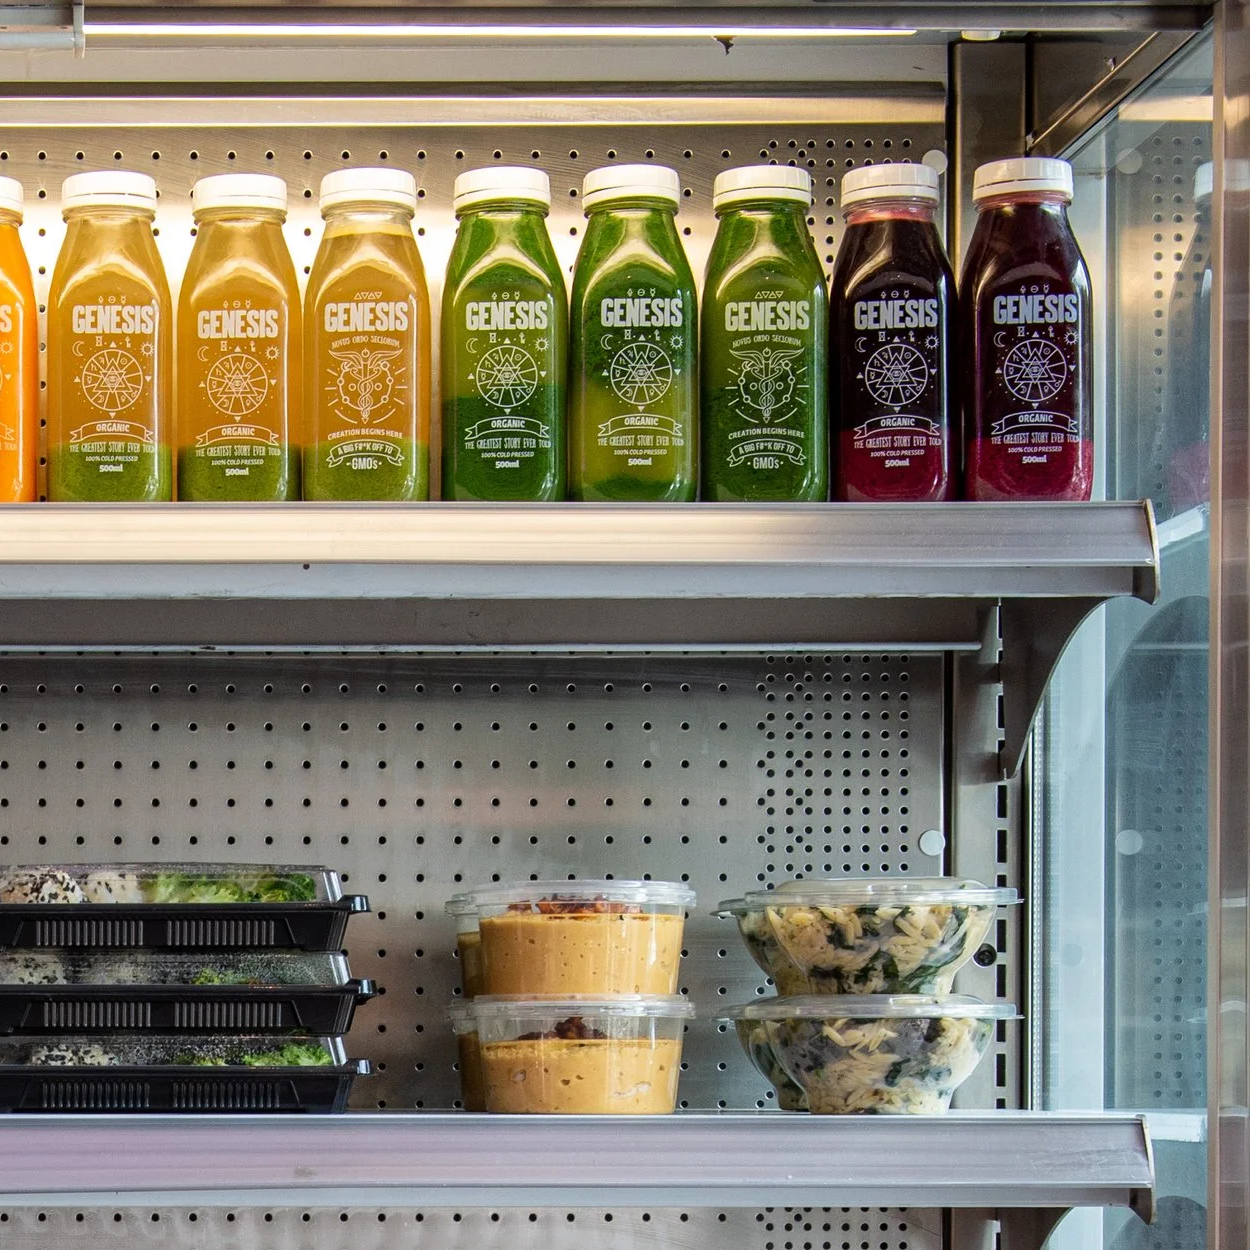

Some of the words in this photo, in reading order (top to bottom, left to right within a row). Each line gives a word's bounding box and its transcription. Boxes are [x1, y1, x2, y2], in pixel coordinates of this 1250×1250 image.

[601, 298, 682, 327] GENESIS
[854, 299, 938, 330] GENESIS
[994, 294, 1077, 325] GENESIS
[72, 305, 153, 334] GENESIS
[324, 302, 408, 332] GENESIS
[466, 302, 548, 330] GENESIS
[725, 302, 810, 331] GENESIS
[198, 310, 278, 338] GENESIS
[491, 419, 525, 428] ORGANIC
[625, 416, 659, 426] ORGANIC
[881, 417, 915, 427] ORGANIC
[1019, 413, 1053, 423] ORGANIC
[97, 423, 129, 432] ORGANIC
[222, 427, 255, 436] ORGANIC
[328, 429, 360, 440] CREATION
[386, 431, 402, 439] HERE
[729, 429, 761, 439] CREATION
[788, 430, 804, 438] HERE
[992, 436, 1001, 444] THE
[1004, 433, 1029, 445] GREATEST
[1031, 432, 1049, 444] STORY
[1051, 433, 1065, 443] EVER
[465, 441, 475, 449] THE
[477, 438, 502, 449] GREATEST
[504, 438, 521, 449] STORY
[523, 438, 537, 448] EVER
[598, 438, 607, 446] THE
[610, 435, 635, 447] GREATEST
[637, 435, 654, 446] STORY
[656, 436, 670, 446] EVER
[854, 440, 864, 449] THE
[866, 436, 891, 449] GREATEST
[894, 436, 911, 448] STORY
[913, 436, 927, 446] EVER
[70, 444, 79, 453] THE
[82, 441, 106, 453] GREATEST
[109, 441, 125, 453] STORY
[128, 443, 140, 453] EVER
[196, 449, 205, 457] THE
[207, 445, 232, 457] GREATEST
[234, 445, 251, 456] STORY
[253, 446, 266, 456] EVER
[343, 445, 354, 453] BIG
[372, 443, 384, 451] OFF
[385, 445, 393, 454] TO
[739, 447, 744, 455] A
[745, 444, 755, 452] BIG
[786, 445, 794, 453] TO
[495, 460, 519, 469] 500ml
[628, 457, 652, 466] 500ml
[885, 458, 909, 468] 500ml
[1023, 454, 1047, 464] 500ml
[100, 463, 123, 473] 500ml
[225, 467, 249, 476] 500ml
